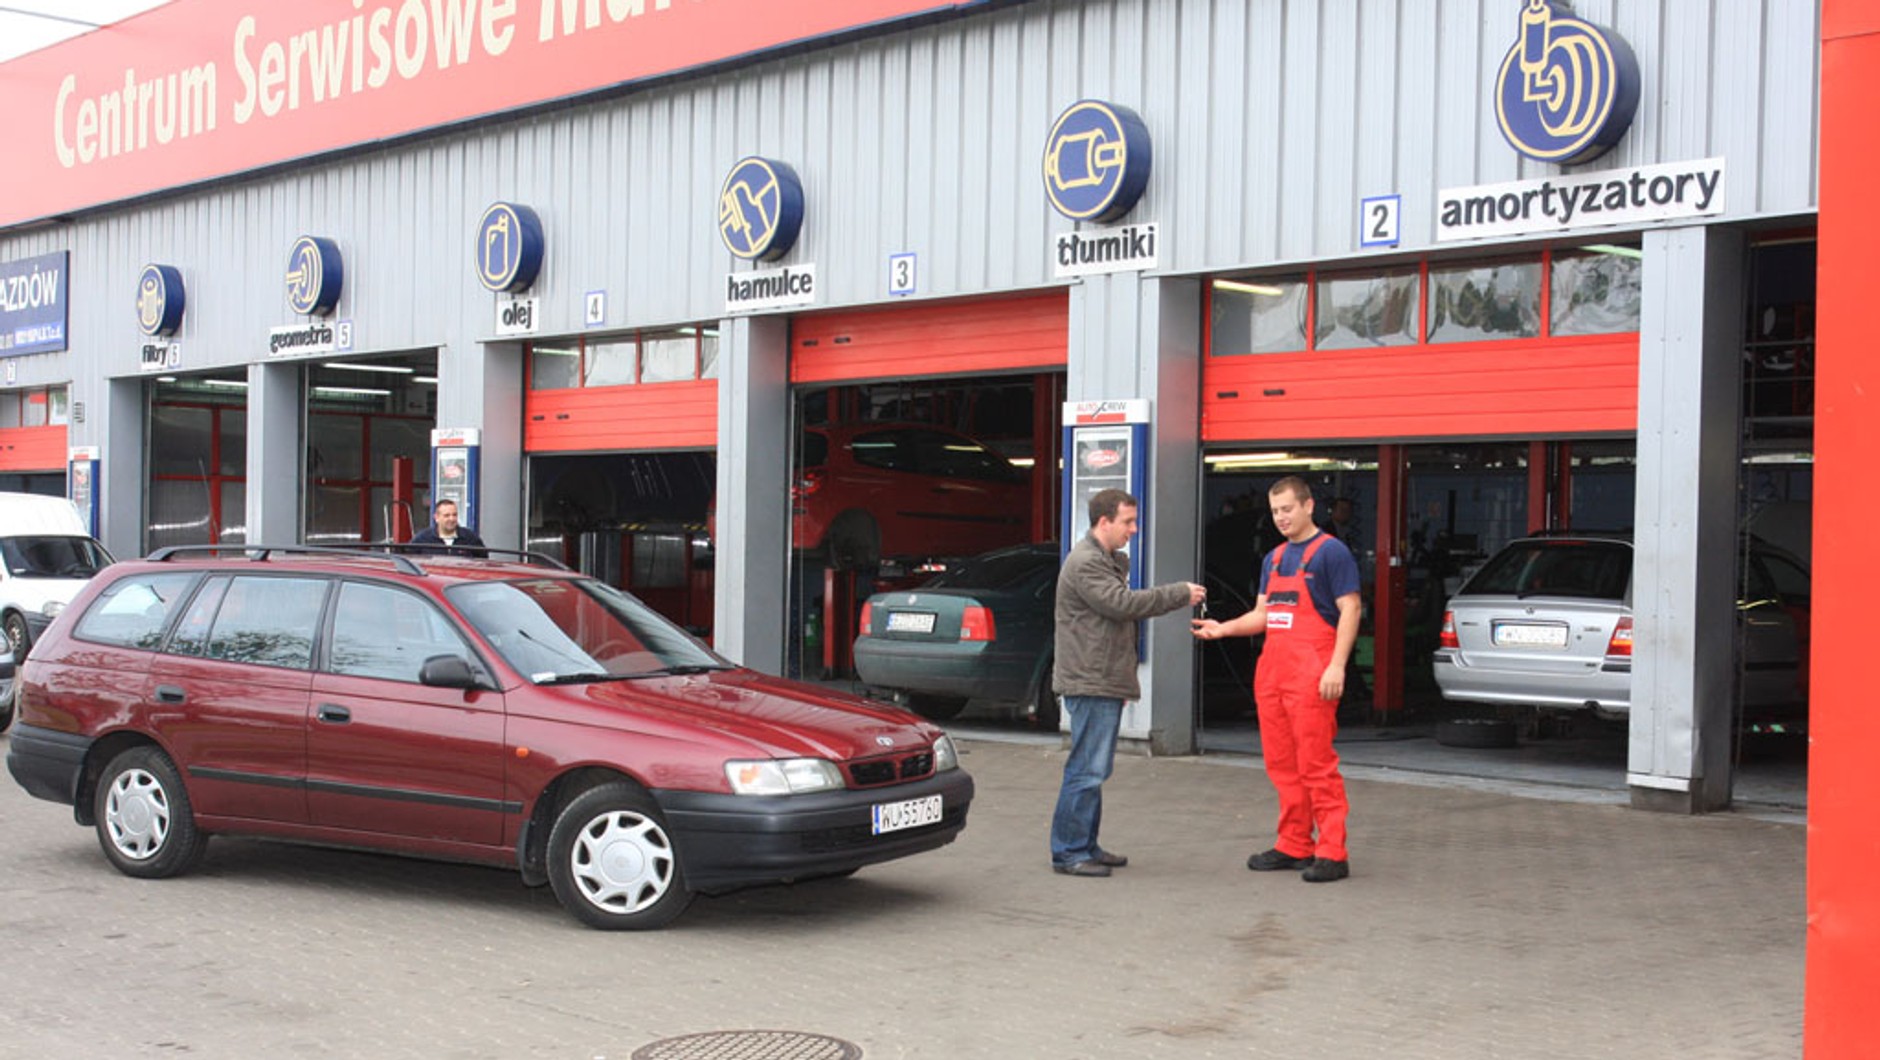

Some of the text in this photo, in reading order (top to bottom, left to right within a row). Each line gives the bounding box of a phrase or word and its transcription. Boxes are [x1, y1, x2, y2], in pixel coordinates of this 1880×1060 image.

[54, 0, 518, 168] Centrum Serwisowe
[1440, 169, 1721, 227] amortyzatory
[1371, 203, 1390, 238] 2
[1057, 226, 1155, 267] tłumiki
[727, 268, 813, 302] hamulce
[896, 260, 909, 288] 3
[502, 300, 532, 329] olej
[590, 297, 599, 320] 4
[142, 344, 169, 366] filtry
[270, 325, 333, 354] geometria
